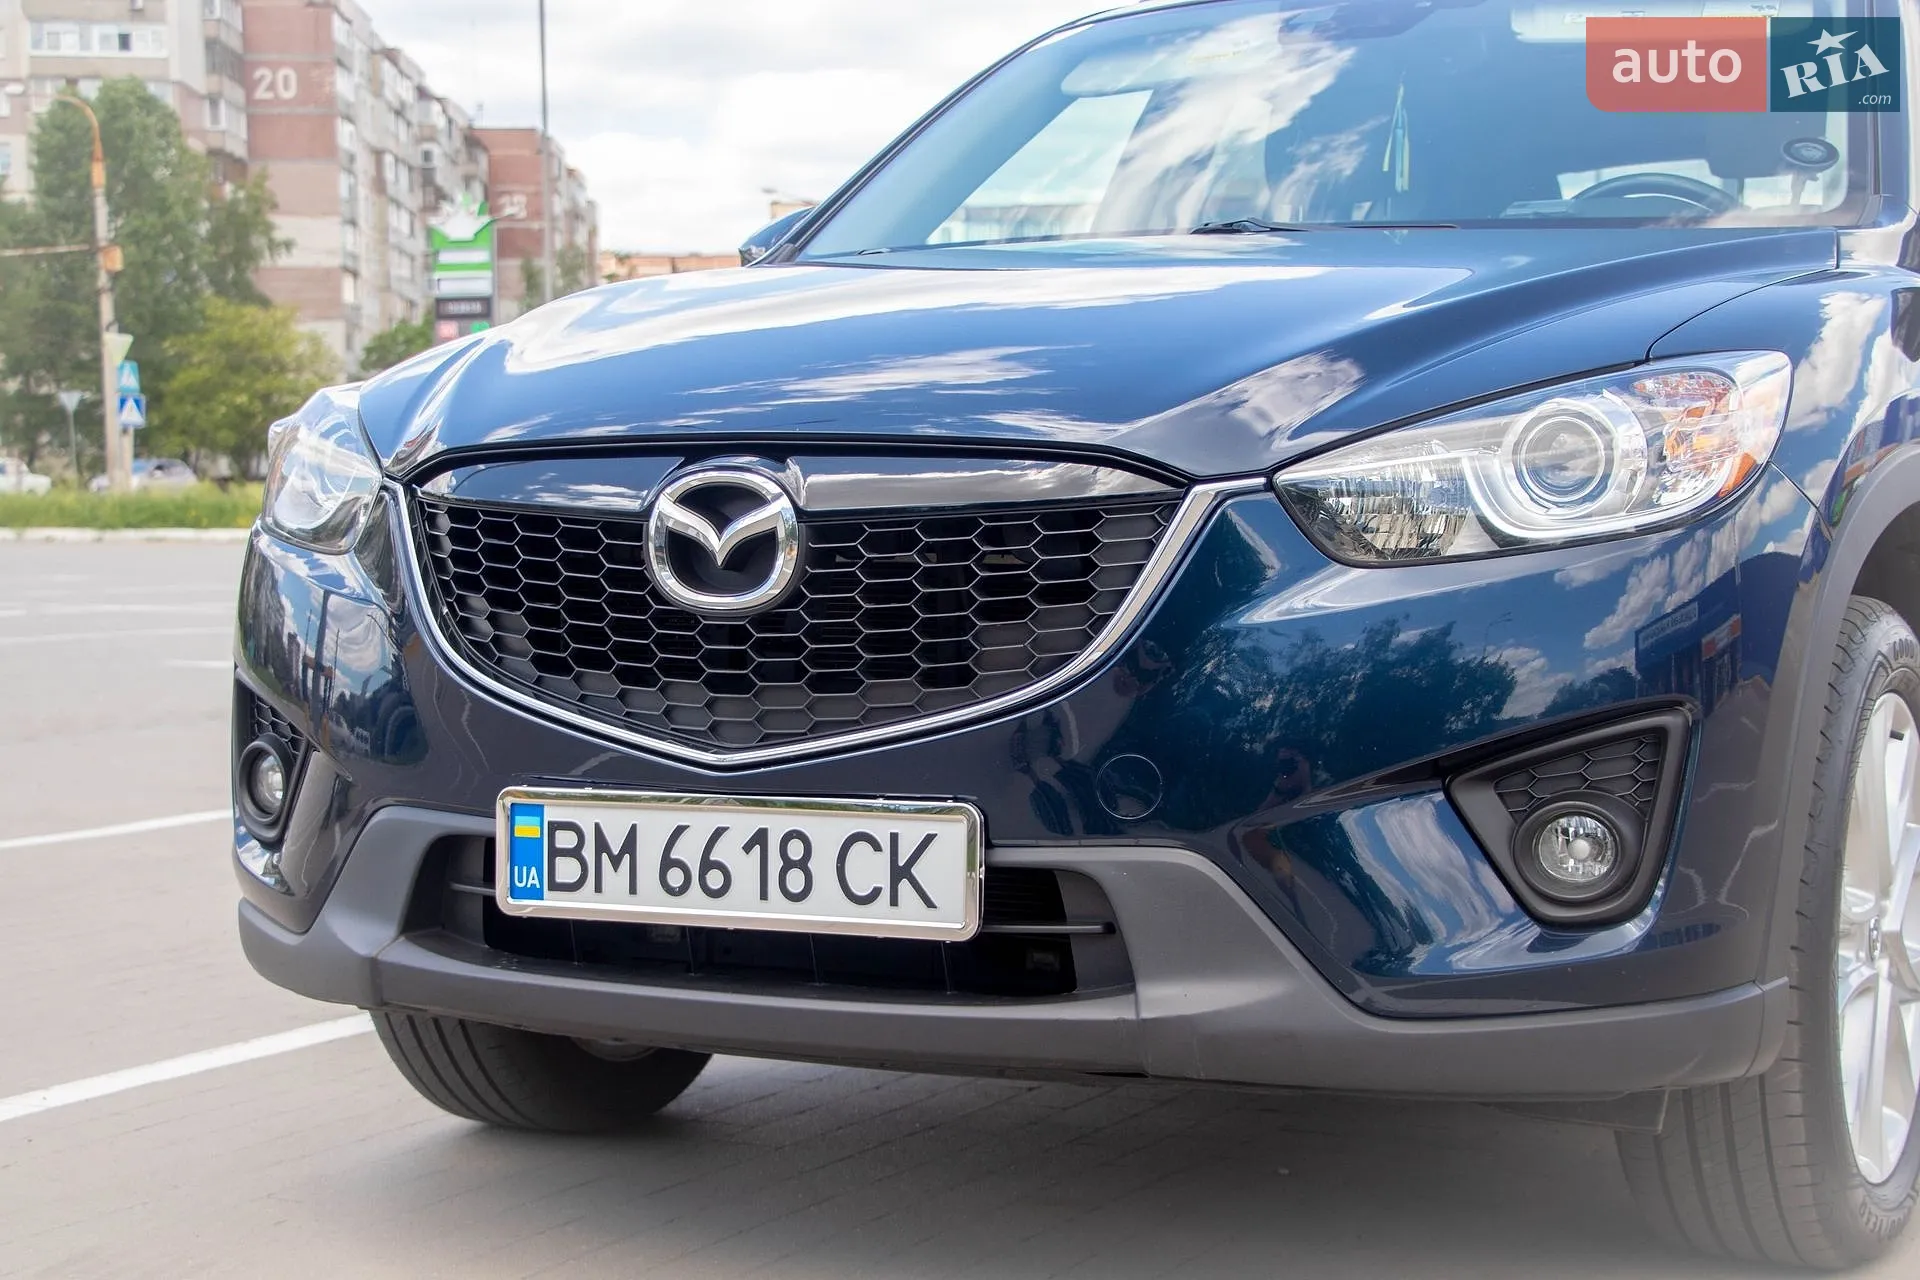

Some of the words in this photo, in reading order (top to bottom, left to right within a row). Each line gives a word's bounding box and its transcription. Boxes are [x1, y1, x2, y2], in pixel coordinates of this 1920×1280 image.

[252, 66, 298, 100] 20
[513, 866, 541, 889] UA
[548, 821, 637, 895] BM
[658, 824, 814, 904] 6618
[836, 831, 937, 908] CK
